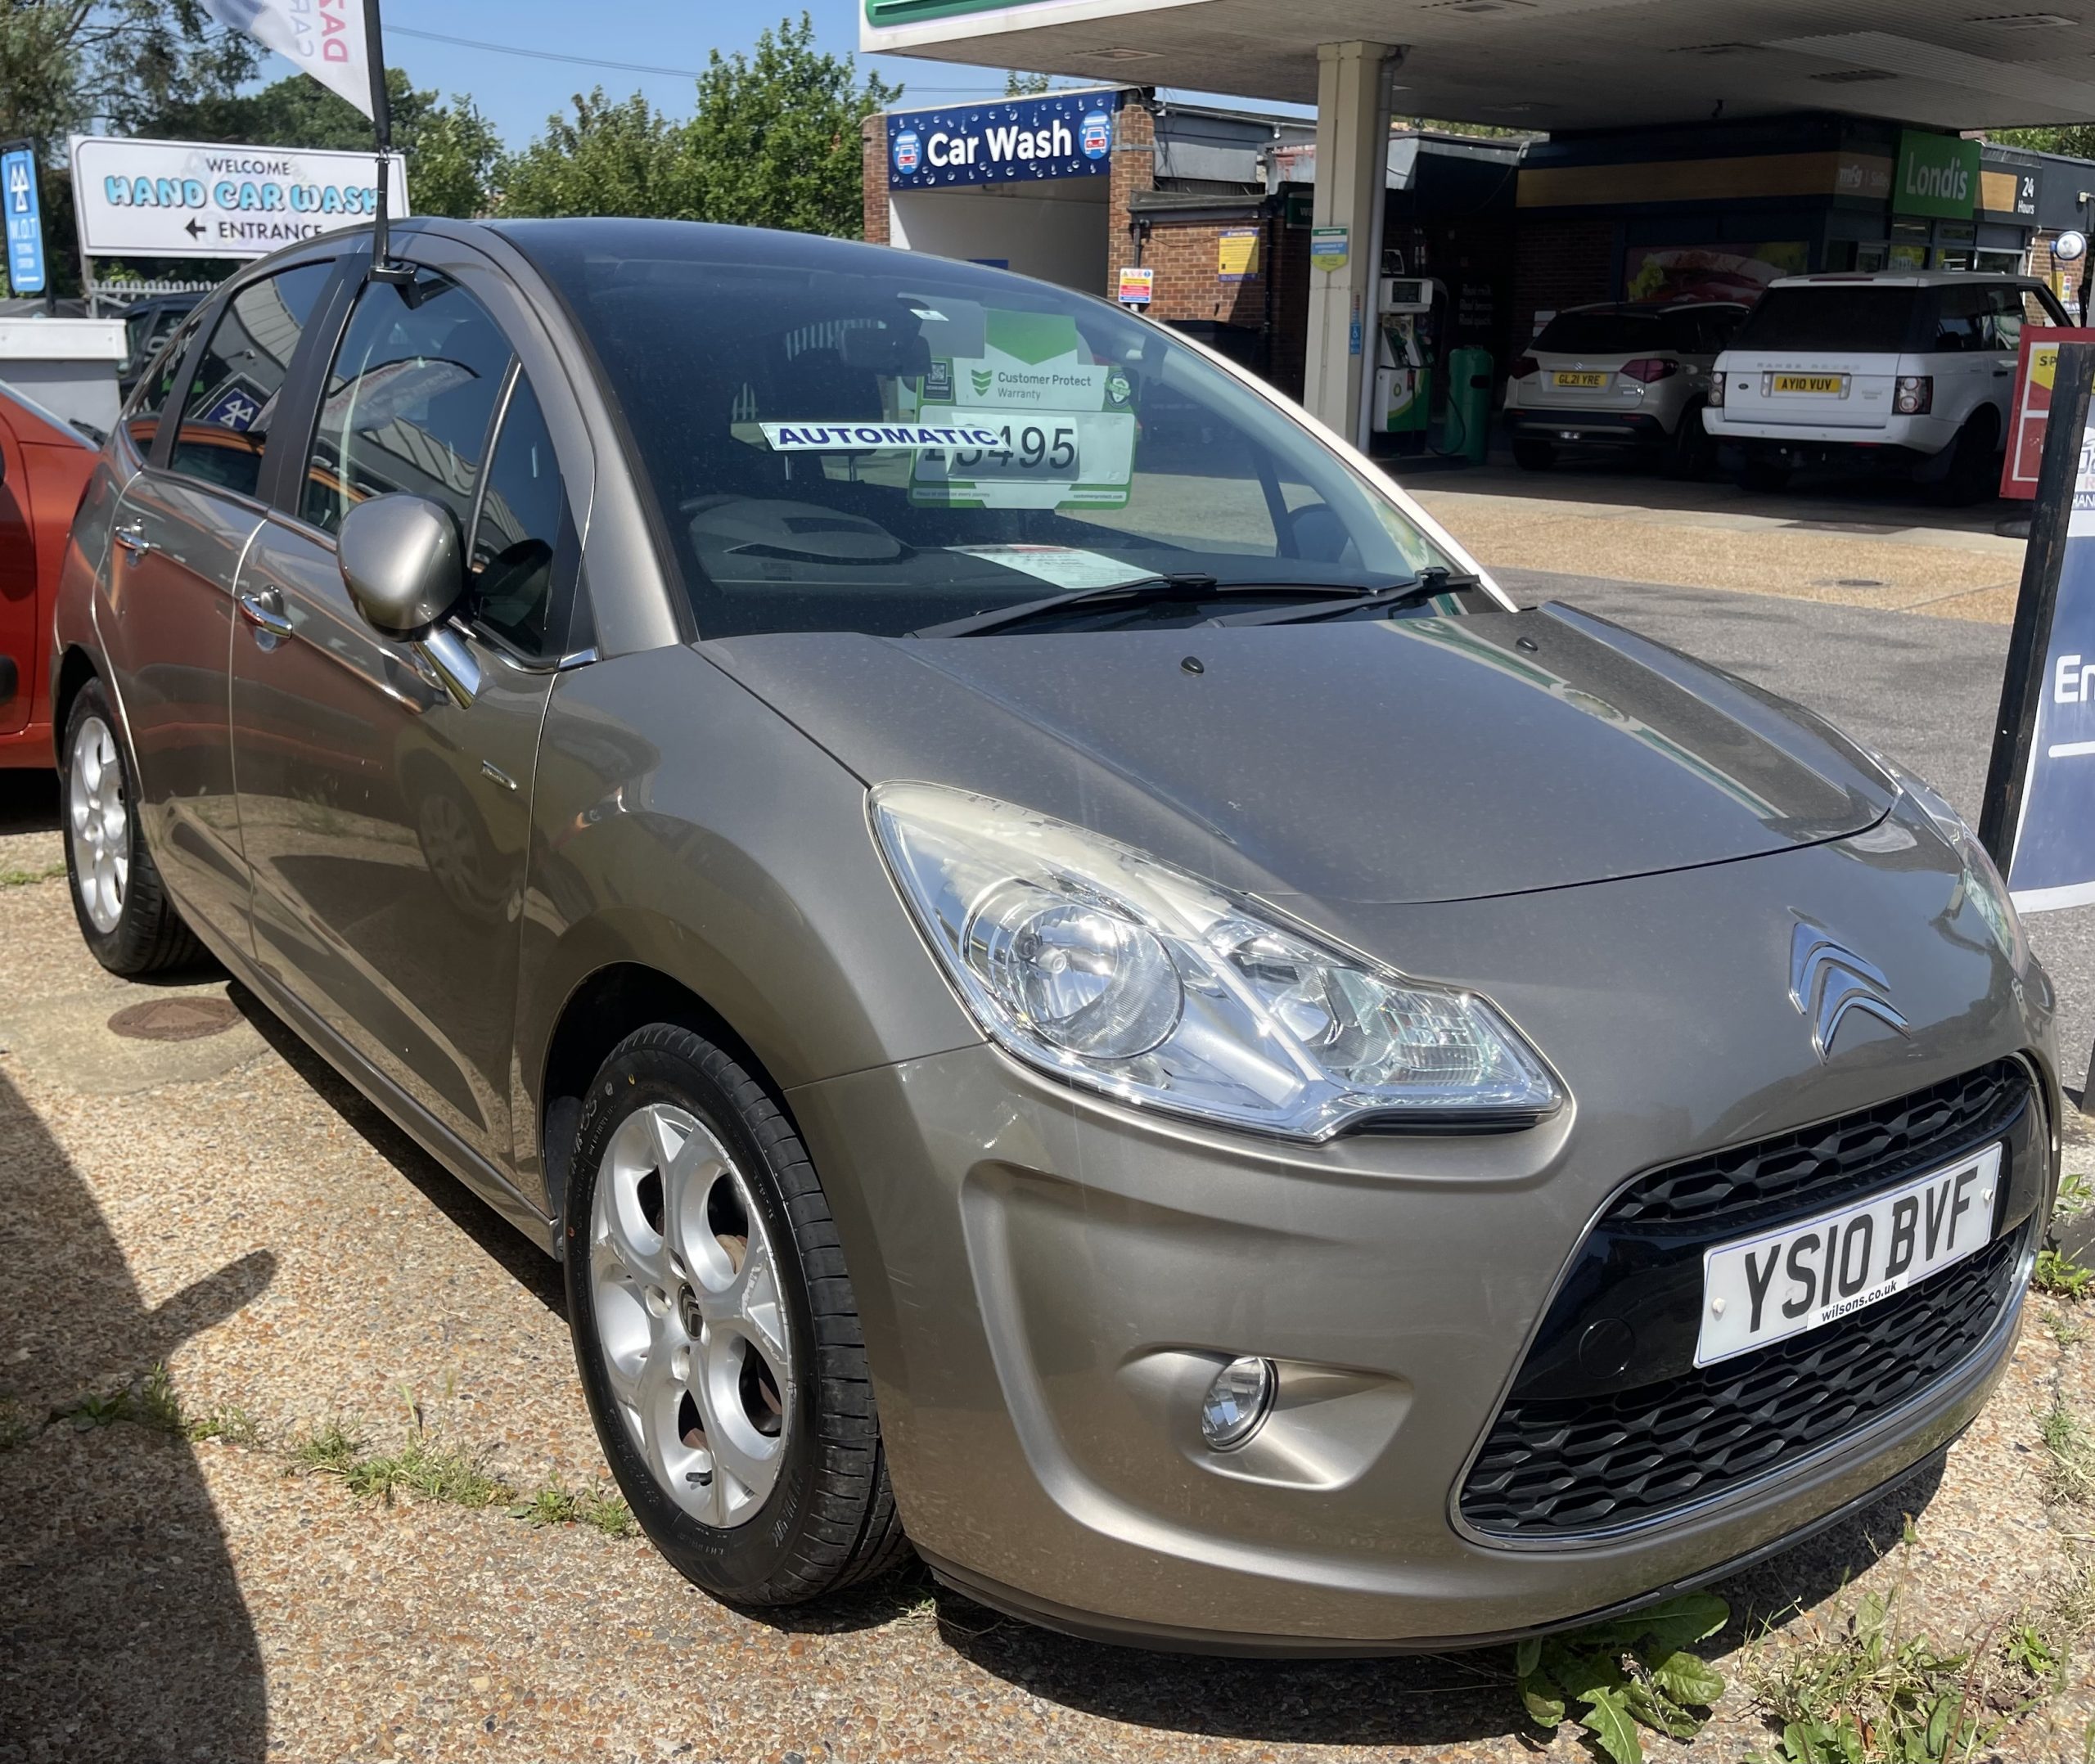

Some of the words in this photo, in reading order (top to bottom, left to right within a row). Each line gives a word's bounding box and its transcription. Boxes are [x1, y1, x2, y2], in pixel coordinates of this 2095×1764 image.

[927, 132, 980, 168] Car
[984, 119, 1073, 163] Wash
[206, 158, 291, 176] WELCOME
[1905, 151, 1969, 200] Londis
[104, 175, 206, 209] HAND
[214, 180, 285, 213] CAR
[2021, 176, 2034, 198] 24
[2017, 199, 2035, 215] Hours
[998, 371, 1050, 385] Customer
[1052, 374, 1092, 387] Protect
[1558, 374, 1579, 385] GL21
[1582, 375, 1601, 385] YRE
[1780, 378, 1807, 390] AY10
[1809, 379, 1832, 391] VUV
[998, 387, 1041, 401] Warranty
[778, 427, 998, 446] AUTOMATIC
[1745, 1213, 1873, 1334] YS10
[1885, 1166, 1979, 1281] BVF
[1822, 1280, 1897, 1323] wilsons.co.uk
